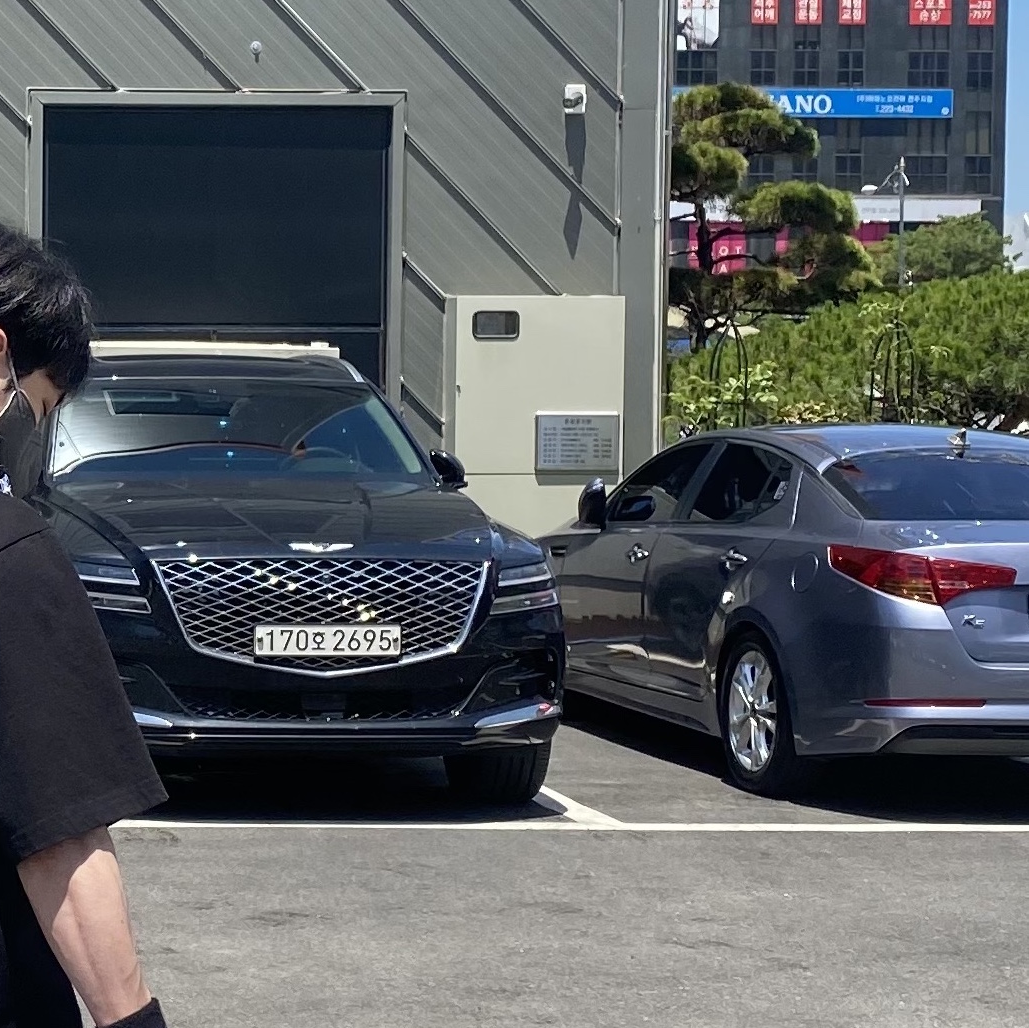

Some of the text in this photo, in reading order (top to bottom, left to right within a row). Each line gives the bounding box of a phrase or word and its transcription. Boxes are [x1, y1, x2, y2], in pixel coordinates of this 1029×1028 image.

[772, 94, 833, 114] ANO
[265, 629, 392, 652] 170호 2695
